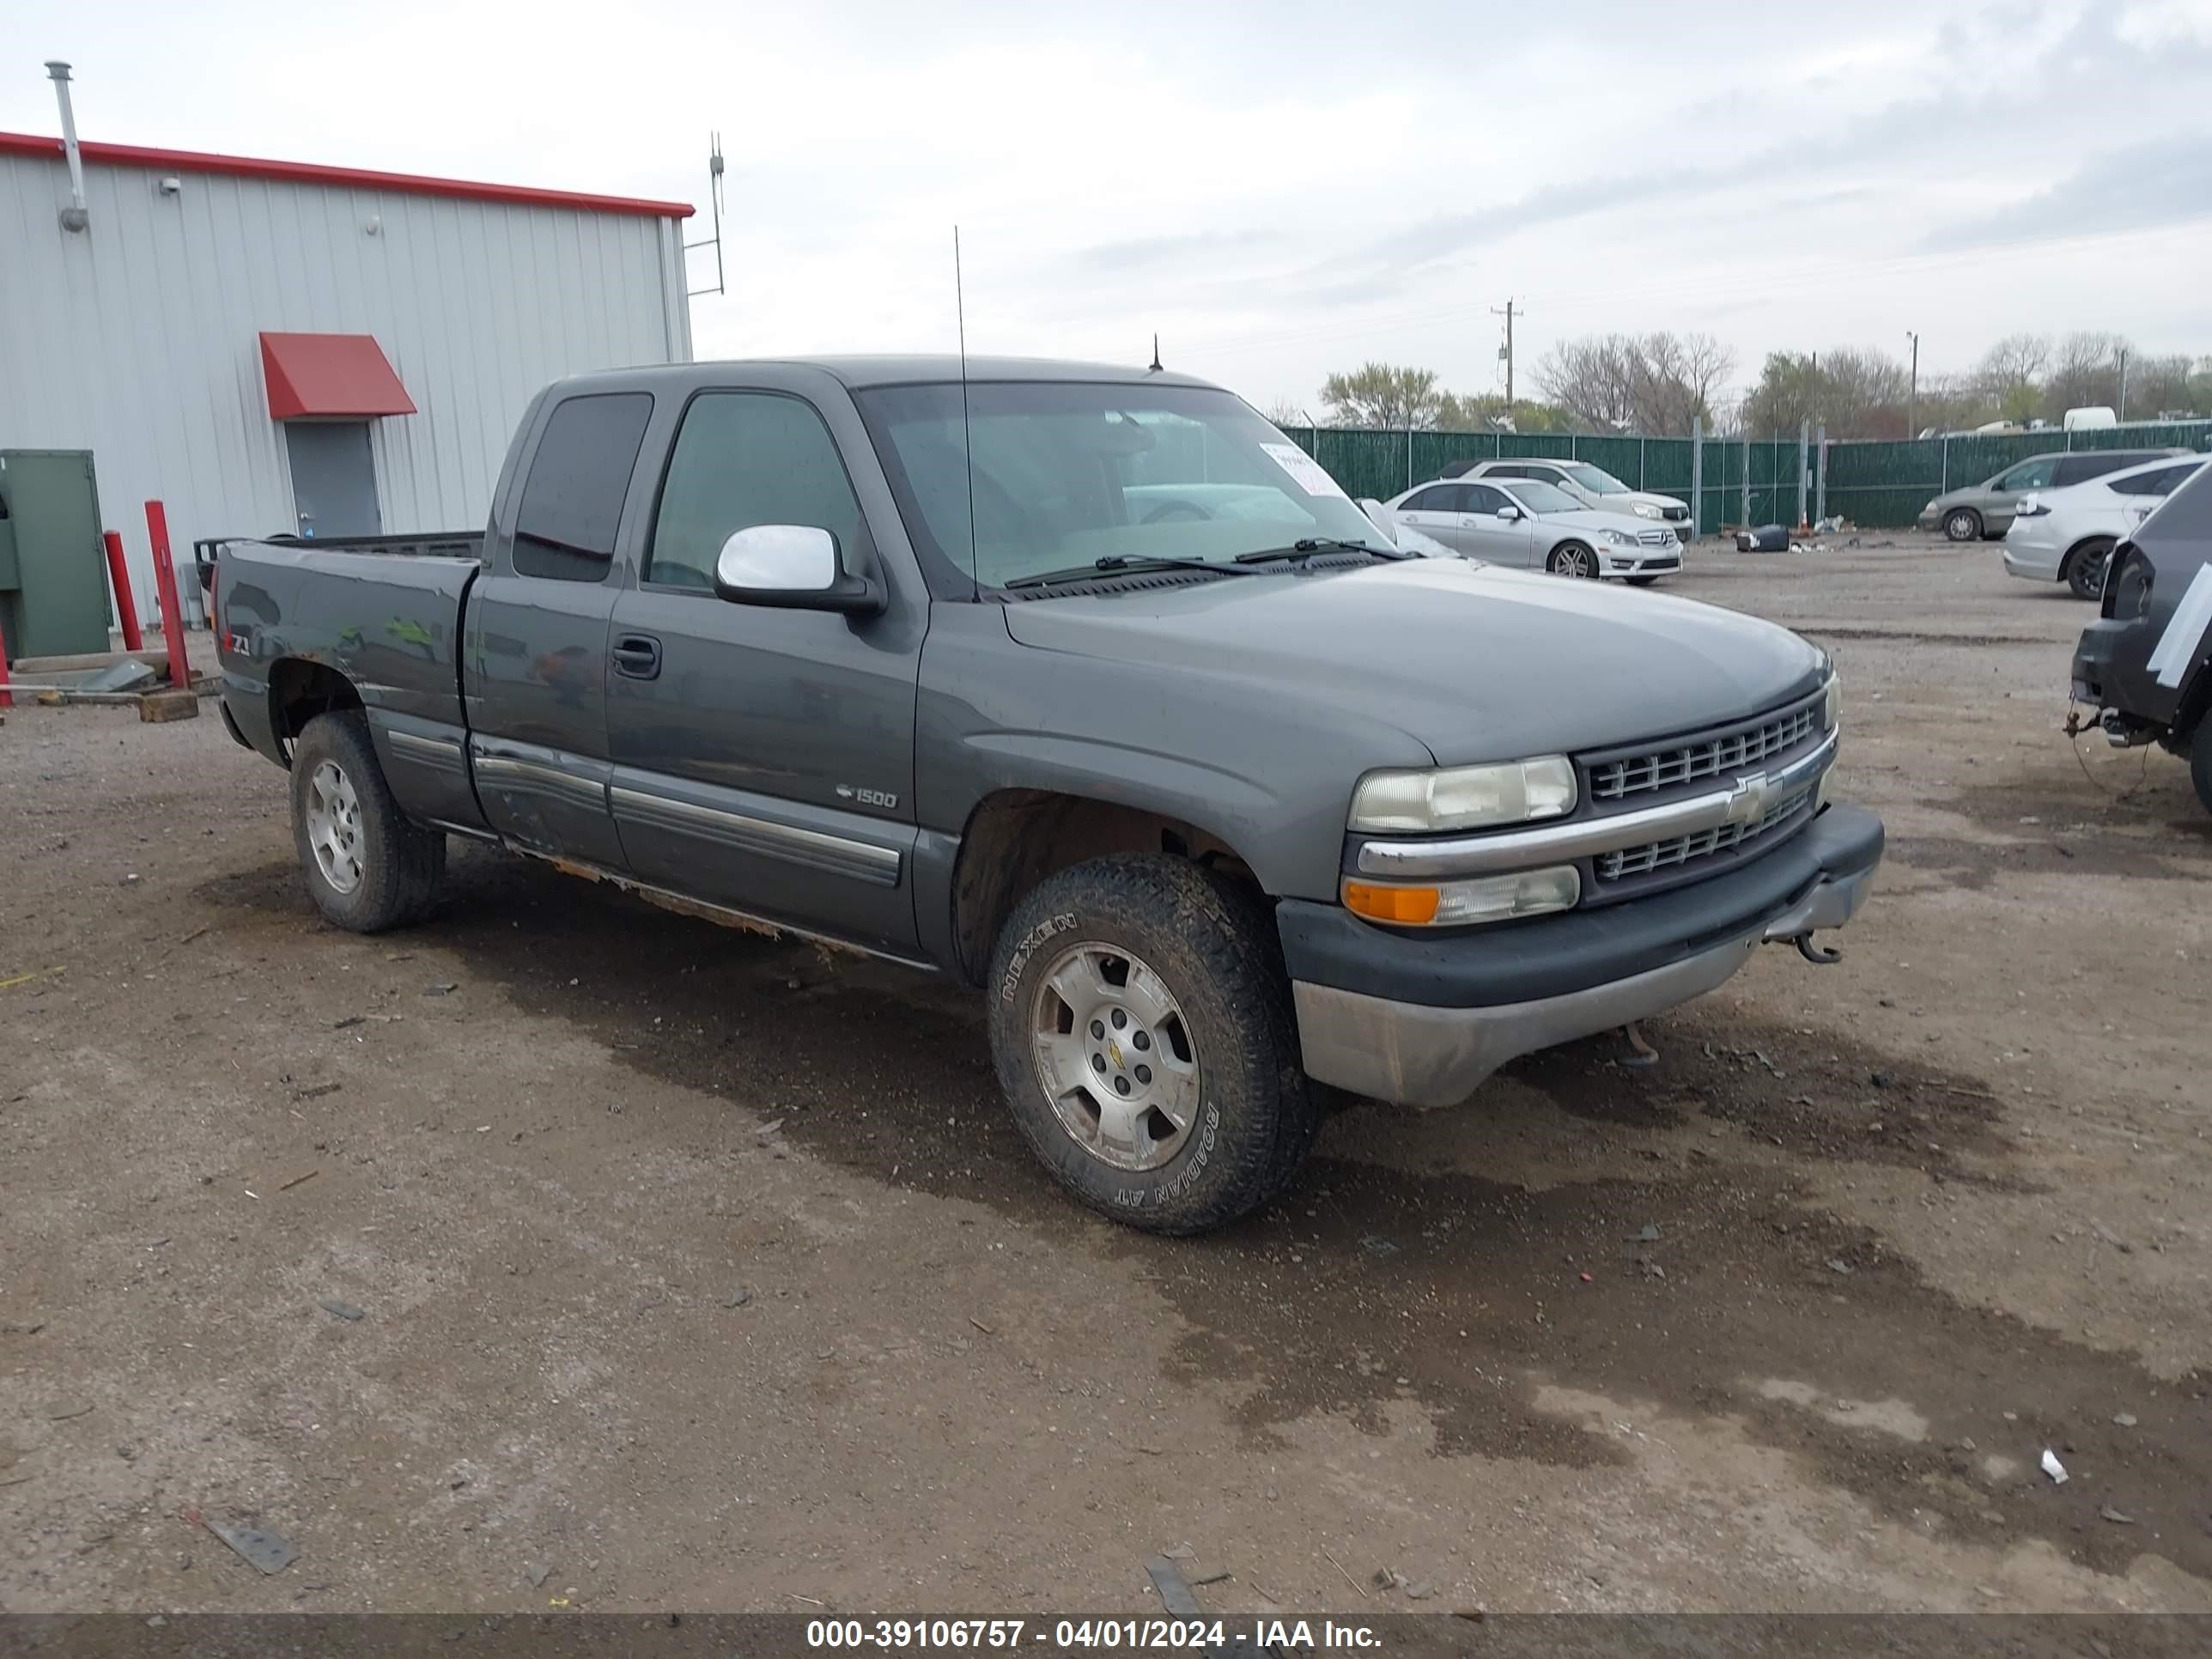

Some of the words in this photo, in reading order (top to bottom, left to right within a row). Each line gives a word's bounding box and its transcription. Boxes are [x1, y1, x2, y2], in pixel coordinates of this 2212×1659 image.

[856, 788, 896, 809] 1500
[1002, 913, 1078, 1002] NEXEN
[1153, 1101, 1219, 1204] ROADIAN
